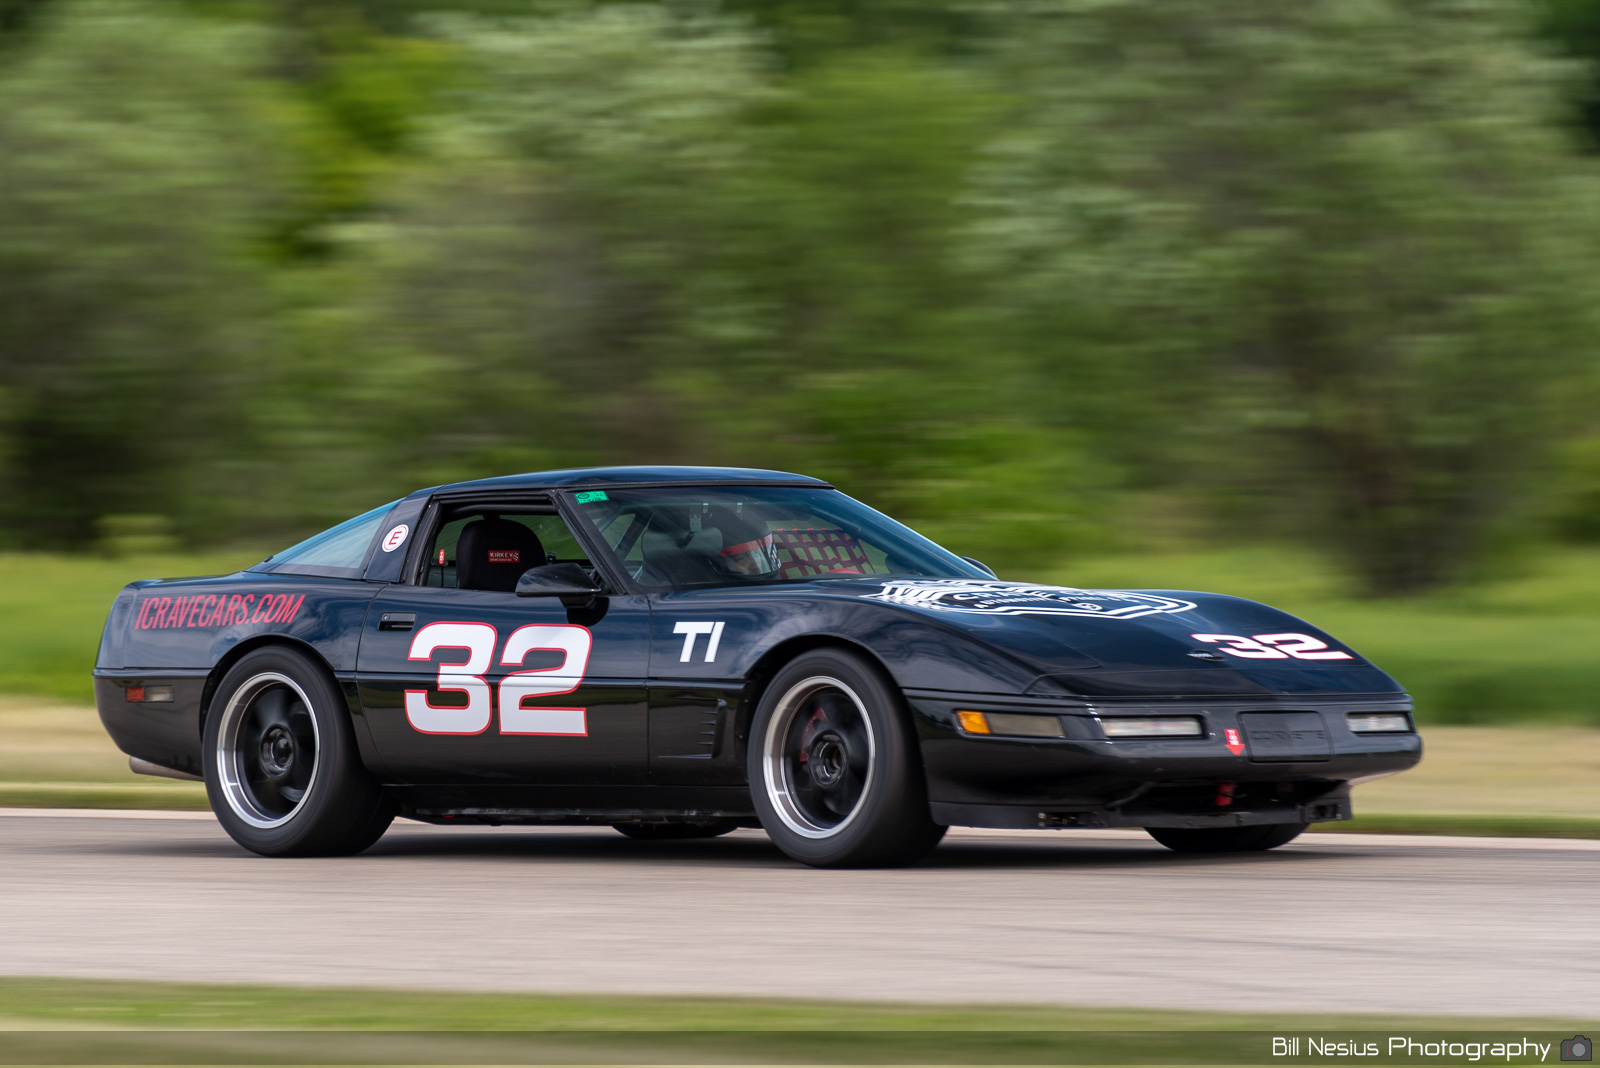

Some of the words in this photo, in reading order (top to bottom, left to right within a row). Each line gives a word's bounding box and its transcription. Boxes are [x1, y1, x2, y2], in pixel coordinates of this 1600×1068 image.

[388, 530, 403, 546] E
[134, 593, 306, 630] ICRAVECARS.COM
[672, 621, 726, 663] TI
[1190, 632, 1355, 661] 32
[404, 621, 592, 737] 32
